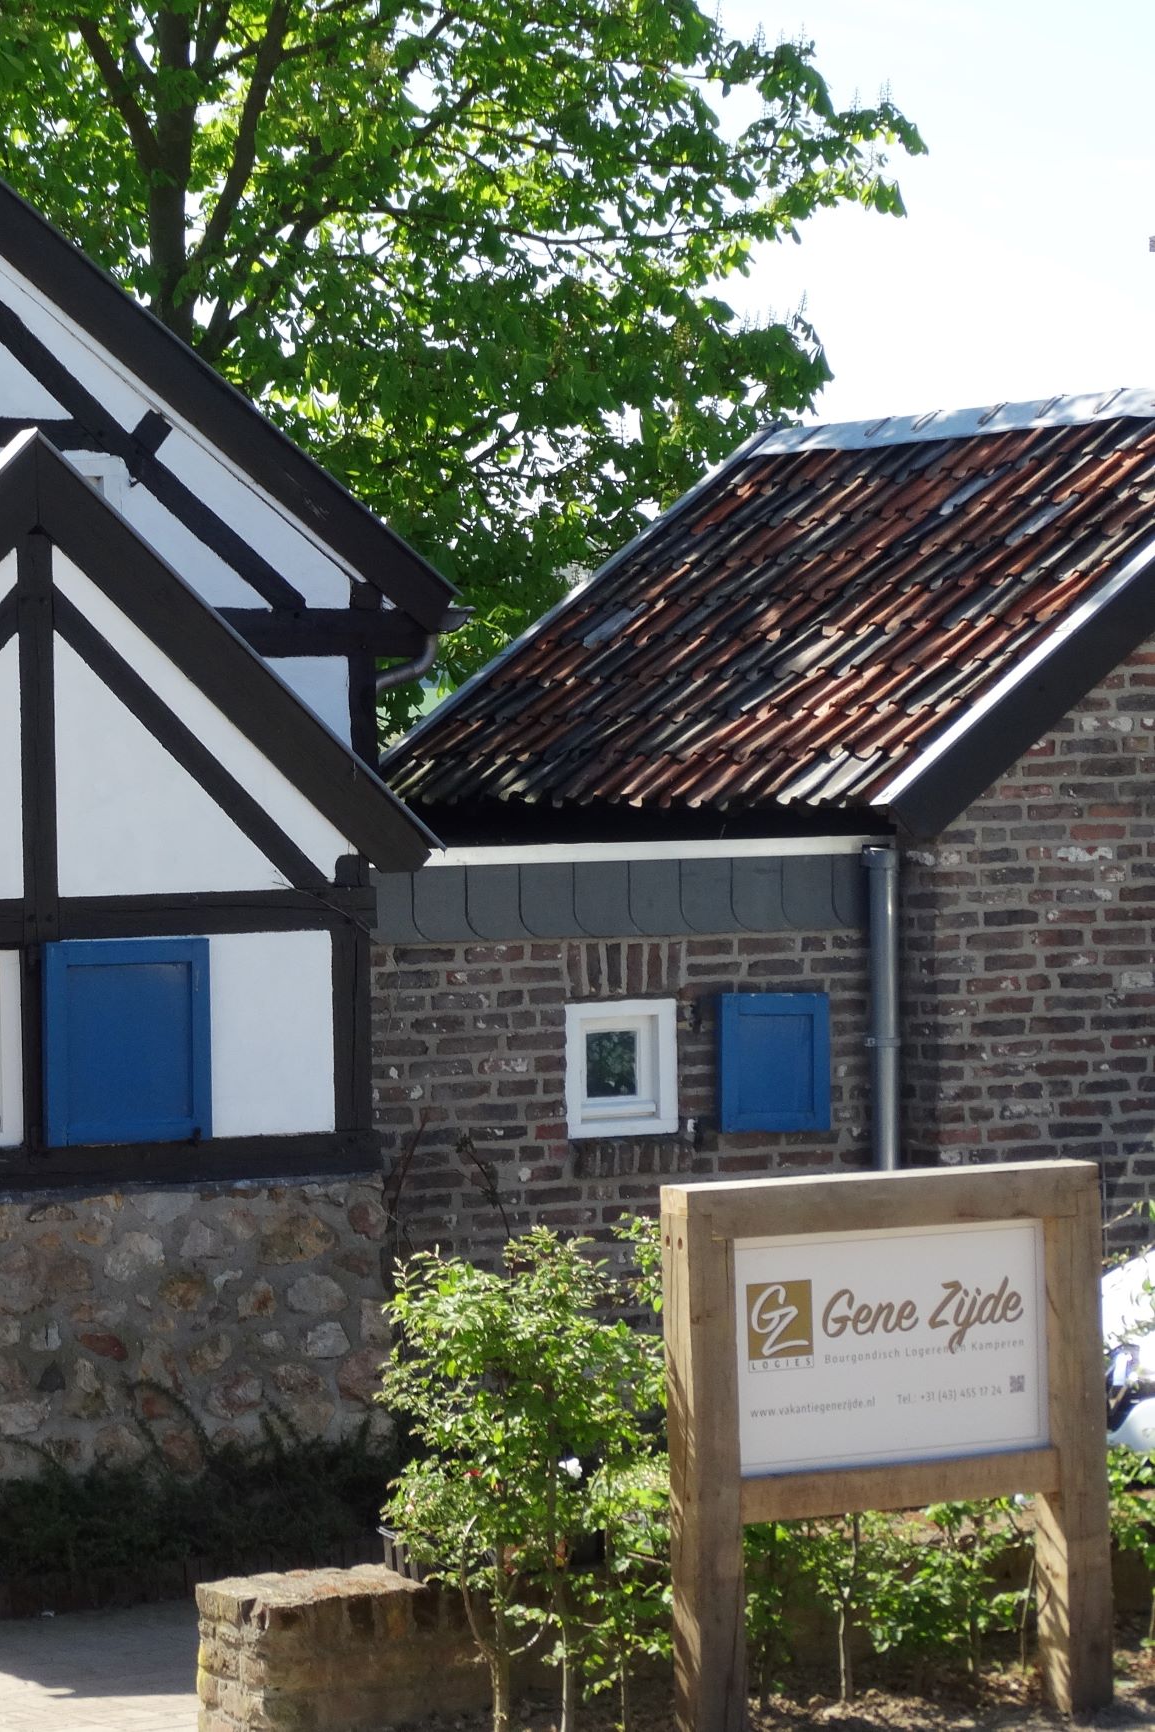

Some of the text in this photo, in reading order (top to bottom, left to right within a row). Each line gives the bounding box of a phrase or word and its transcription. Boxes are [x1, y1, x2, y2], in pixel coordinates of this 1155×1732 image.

[751, 1285, 810, 1357] GZ
[822, 1288, 919, 1338] Gene
[752, 1358, 811, 1370] LOGIES
[824, 1347, 900, 1364] Bourgondisch
[971, 1338, 1025, 1352] Kamperen
[938, 1389, 957, 1403] (43)
